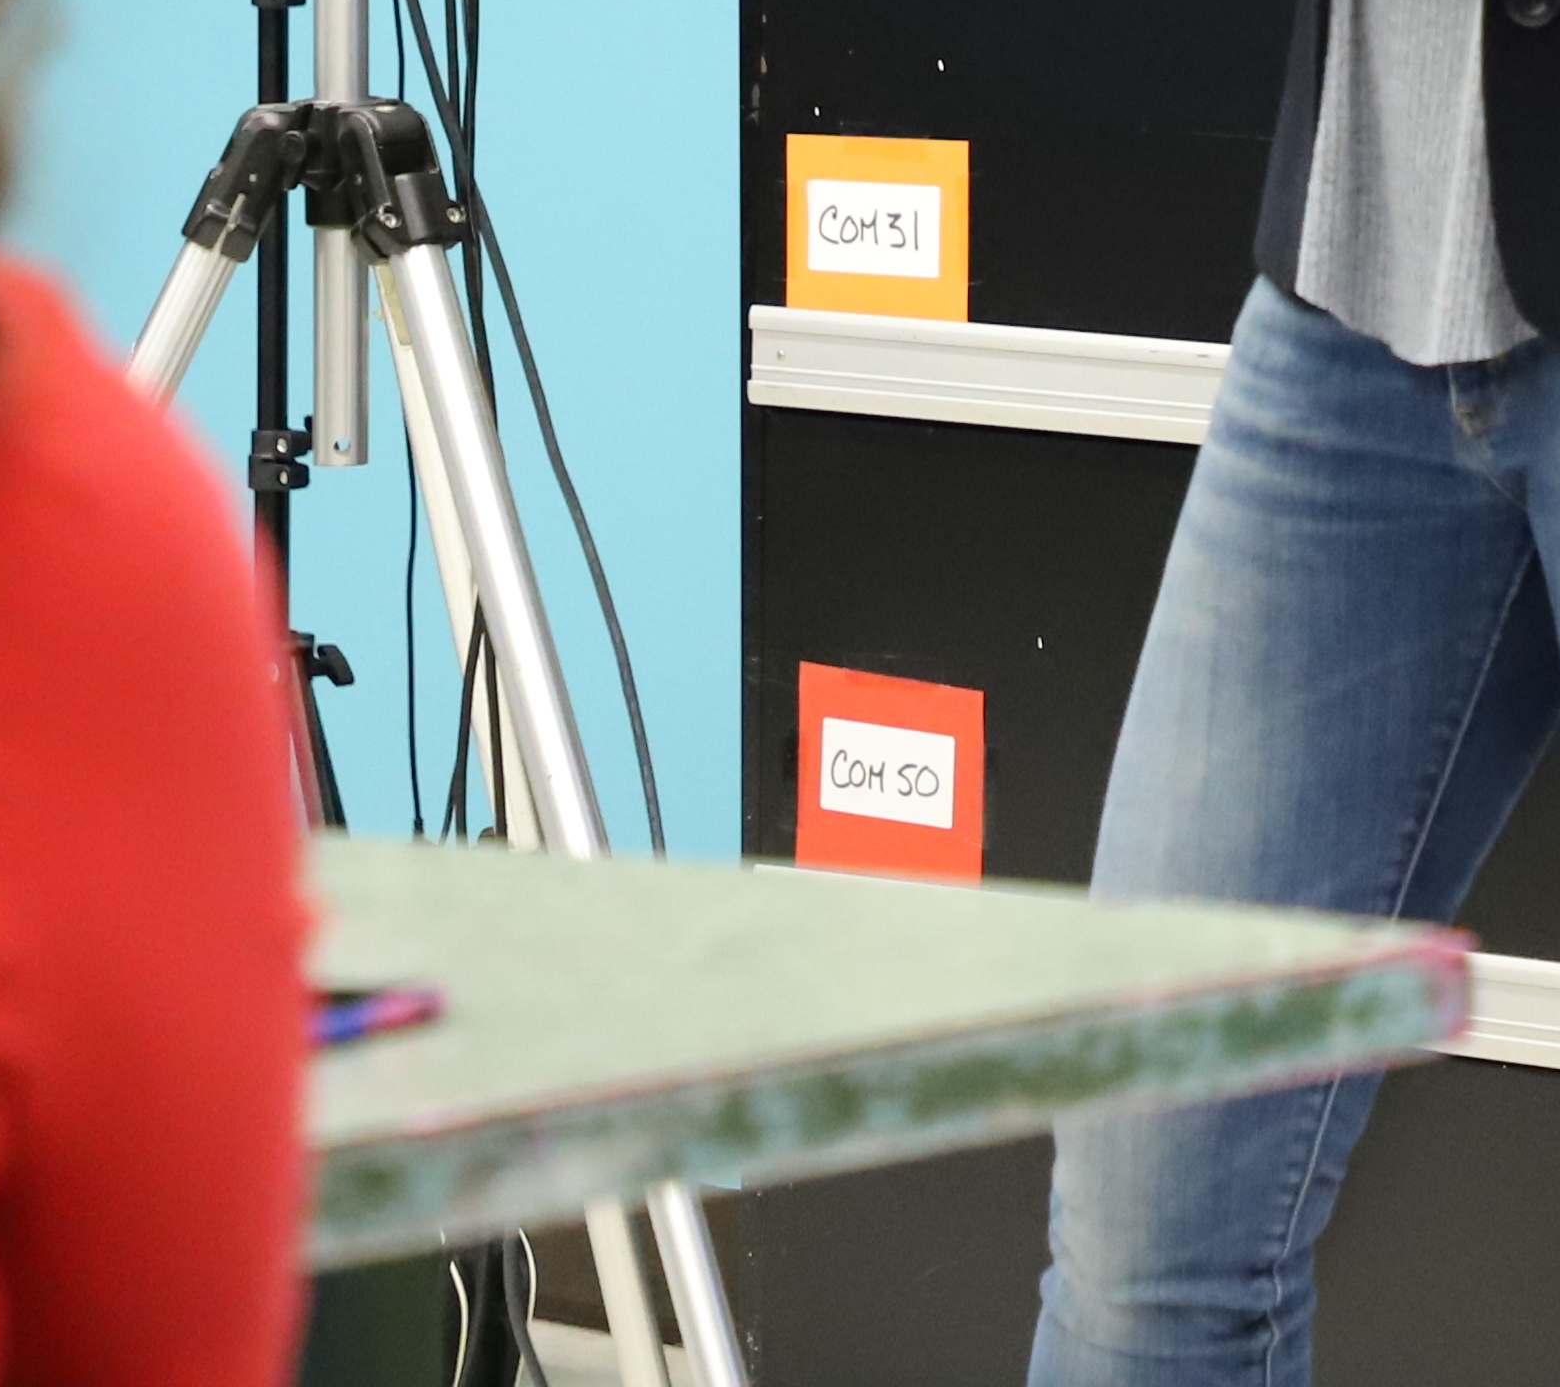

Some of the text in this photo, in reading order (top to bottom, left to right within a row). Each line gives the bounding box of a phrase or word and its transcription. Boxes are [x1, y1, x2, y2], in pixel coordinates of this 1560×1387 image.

[819, 205, 919, 251] COM 31
[831, 749, 940, 798] COM 50
